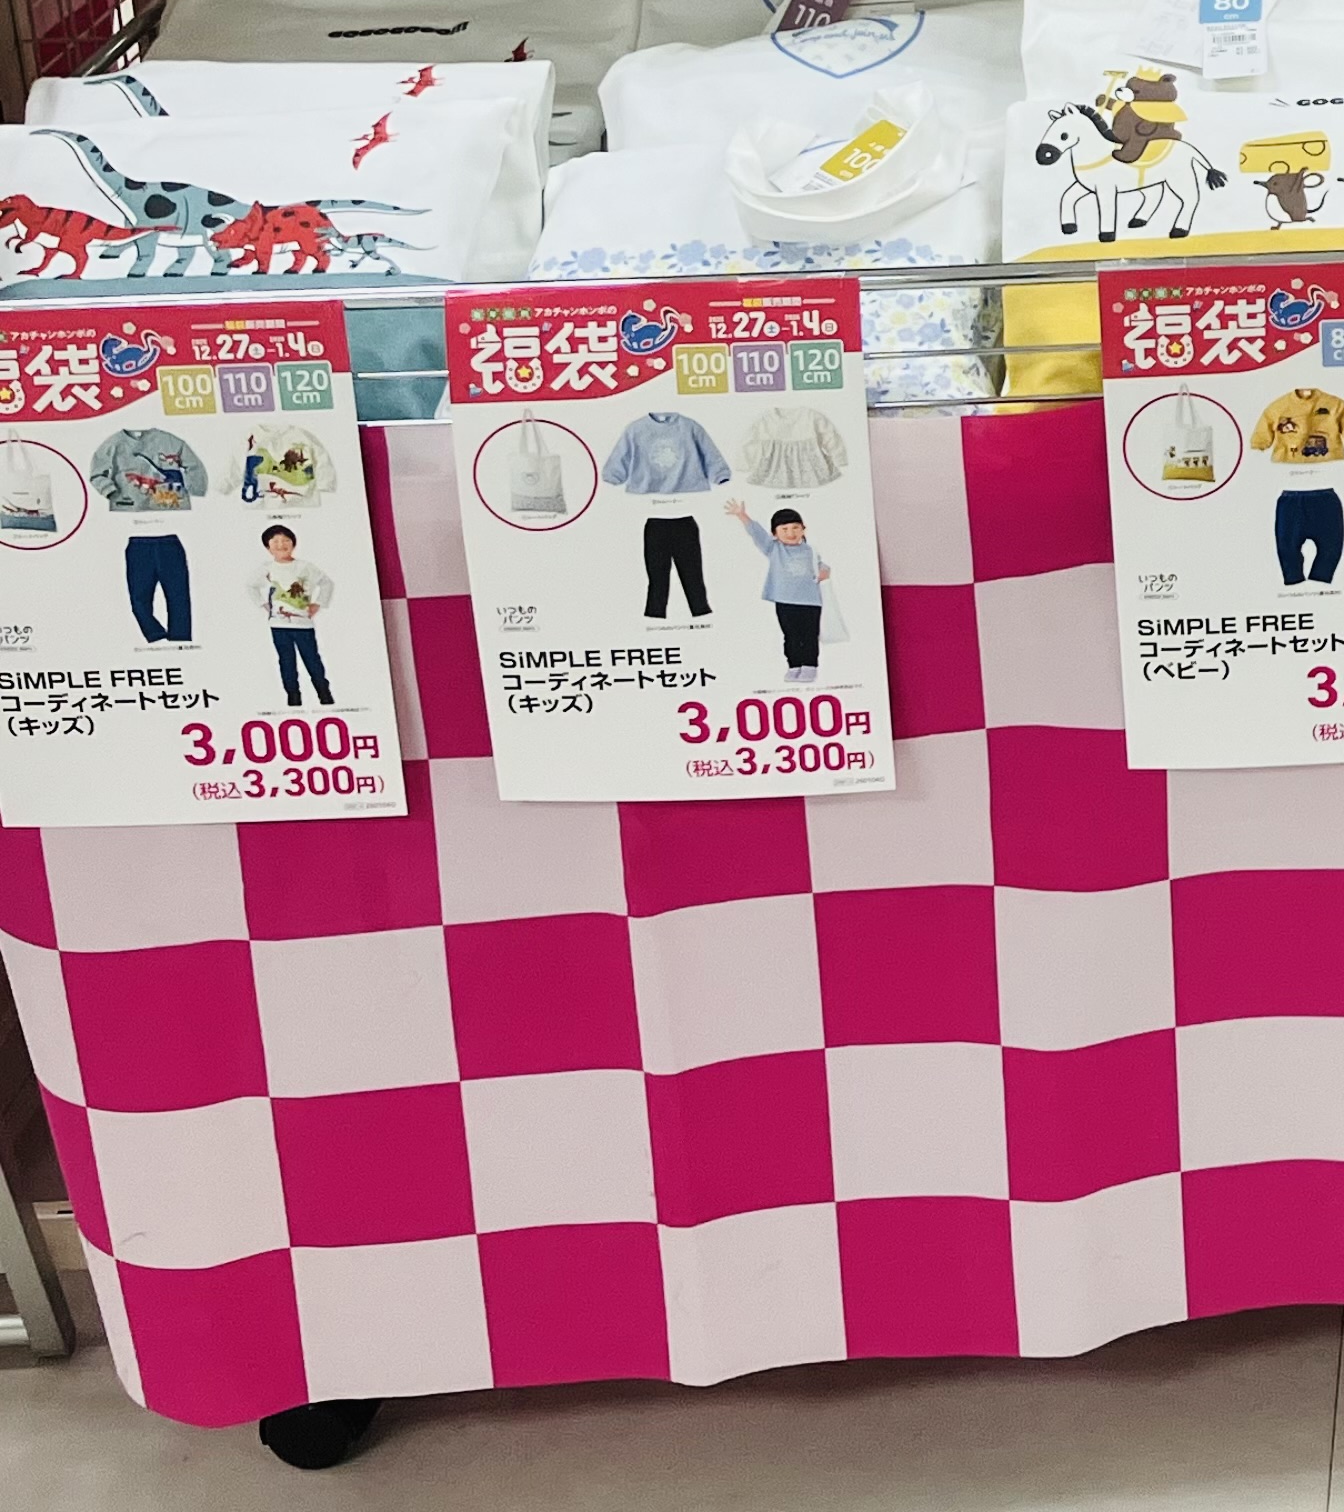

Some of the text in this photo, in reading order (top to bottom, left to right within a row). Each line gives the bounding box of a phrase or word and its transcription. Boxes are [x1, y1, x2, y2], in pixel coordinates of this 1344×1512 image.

[1123, 299, 1267, 370] 福袋
[469, 322, 619, 395] 福袋
[677, 353, 726, 375] 100
[737, 351, 780, 373] 110
[793, 348, 840, 370] 120
[1246, 613, 1315, 632] FREE
[611, 647, 682, 666] FREE
[110, 668, 184, 686] FREE
[502, 668, 717, 692] コーディネートセット
[1143, 660, 1231, 681] (ベビー)
[2, 689, 219, 713] コーディネートセット
[507, 693, 594, 714] (キッズ)
[8, 715, 95, 737] (キッズ)
[677, 695, 872, 745] 3,000円
[180, 717, 380, 767] 3,000円
